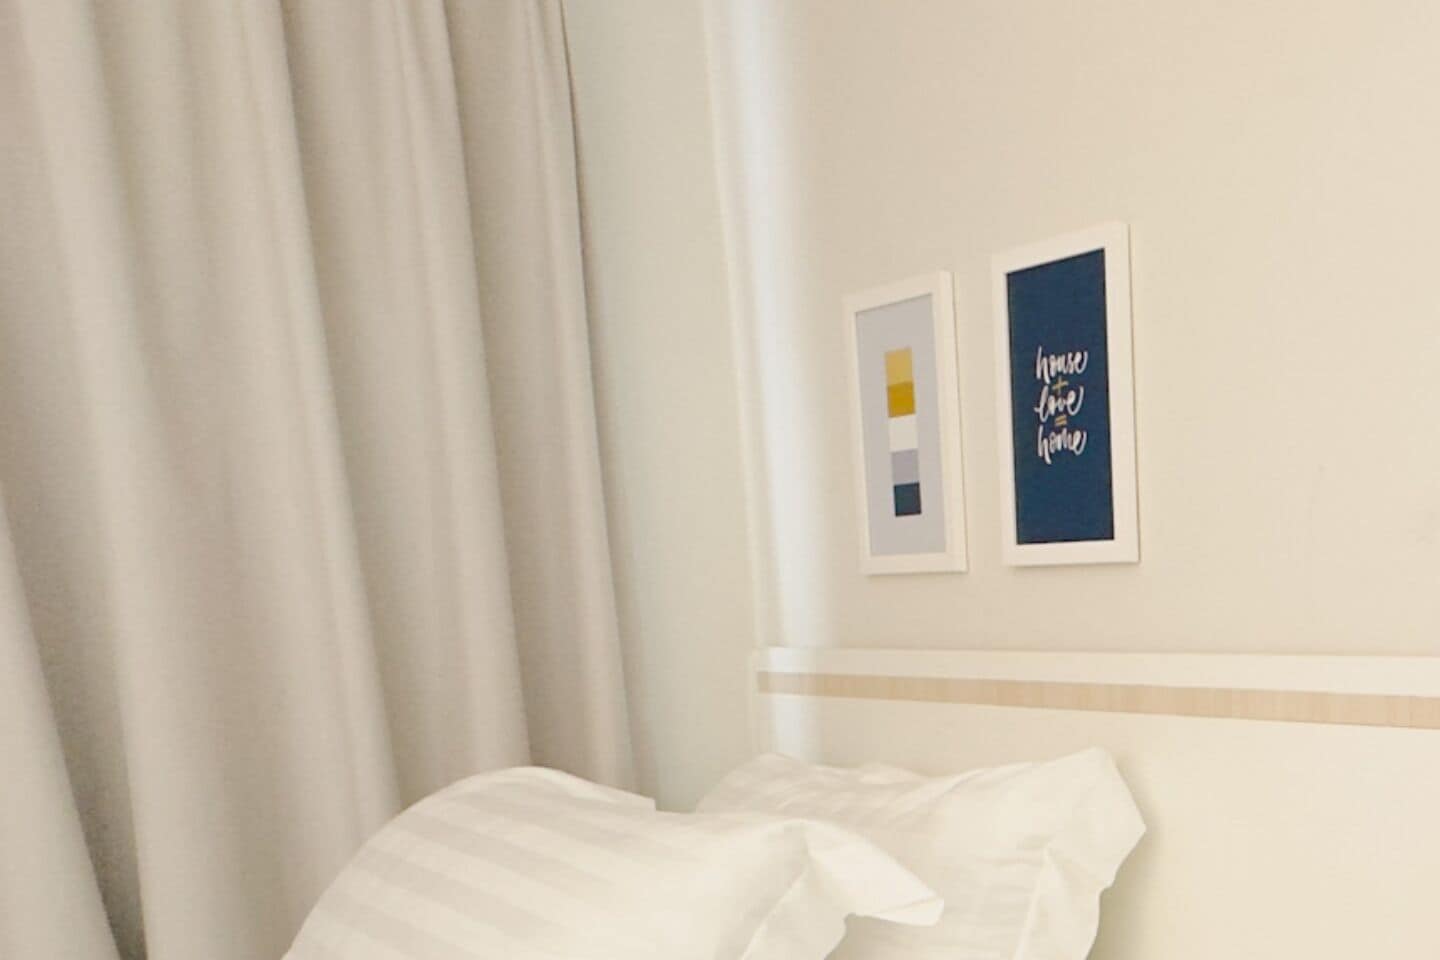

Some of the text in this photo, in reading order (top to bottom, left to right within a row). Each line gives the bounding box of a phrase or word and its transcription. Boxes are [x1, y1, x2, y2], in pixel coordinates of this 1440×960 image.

[1036, 345, 1088, 384] house
[1033, 385, 1084, 422] love
[1038, 424, 1087, 464] home
